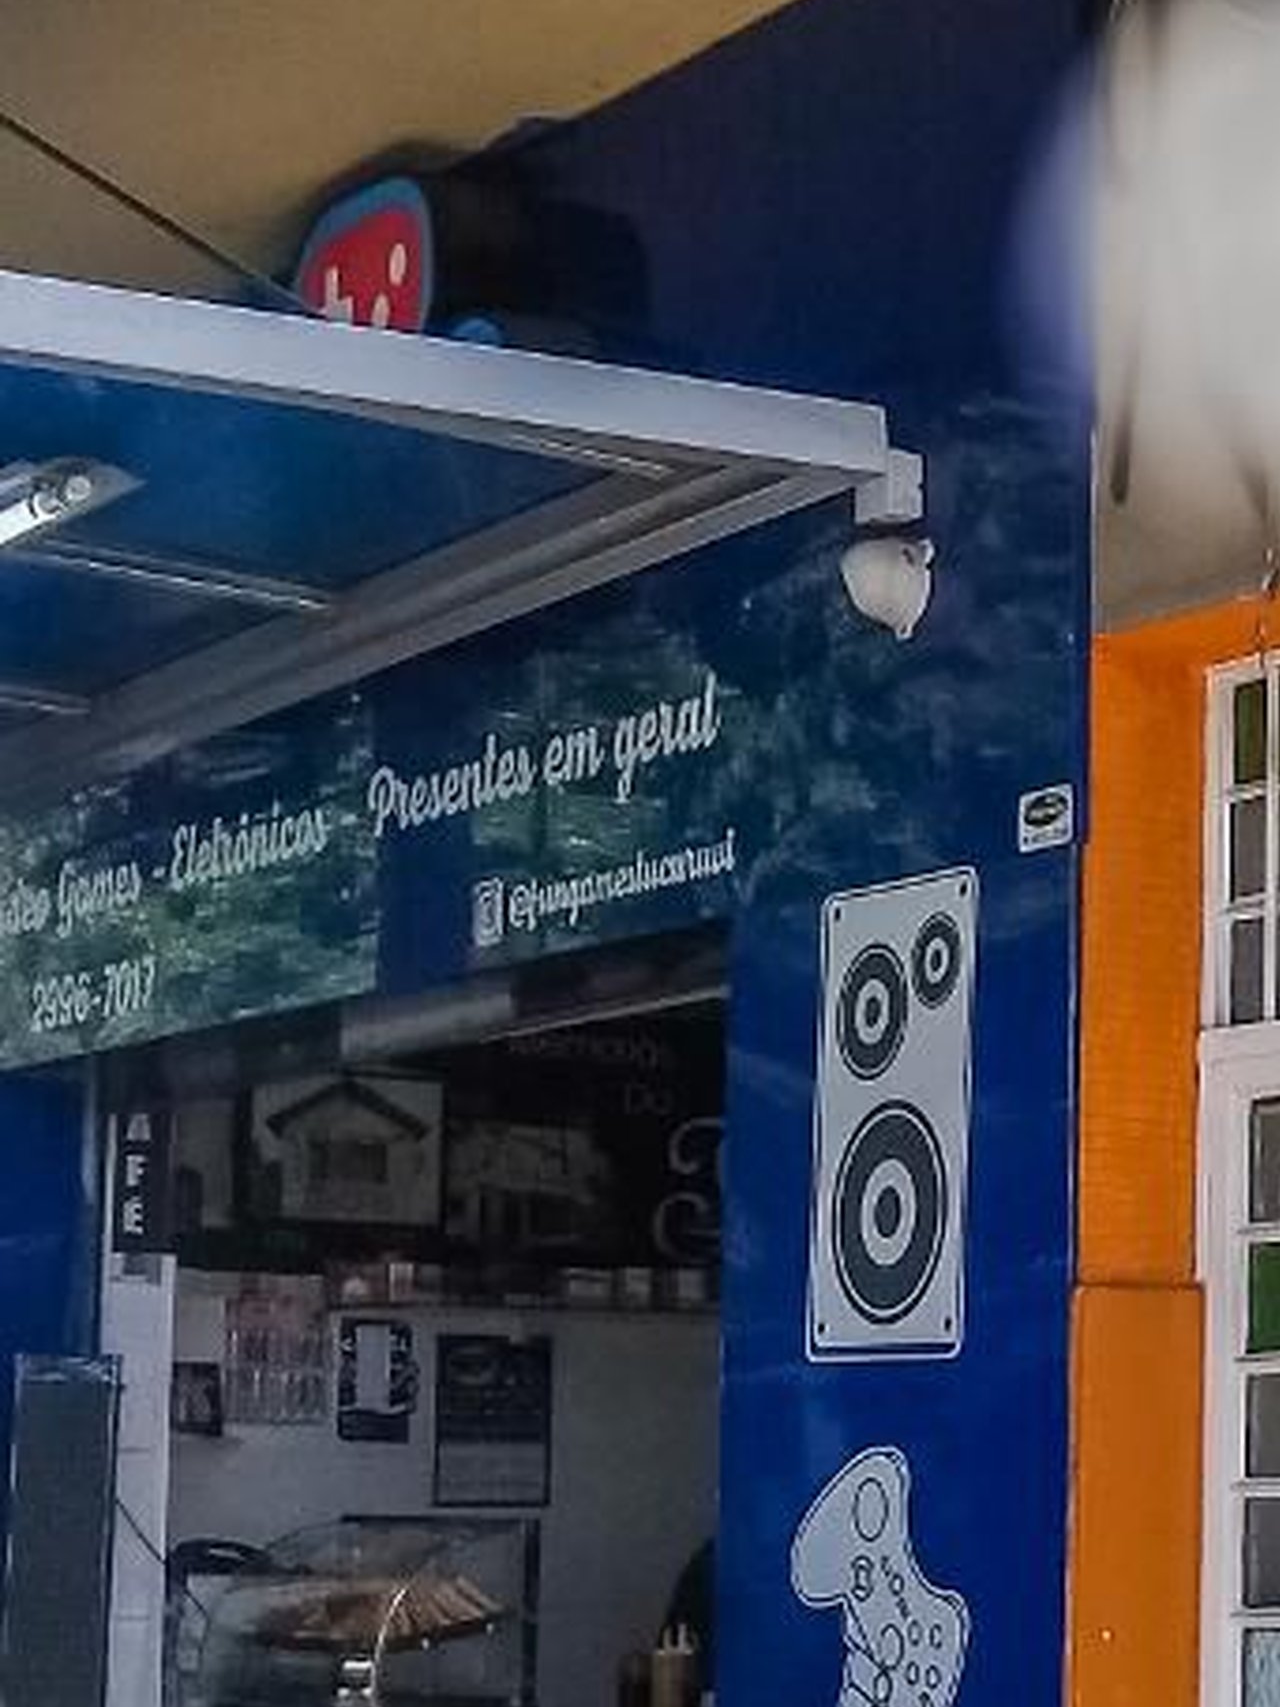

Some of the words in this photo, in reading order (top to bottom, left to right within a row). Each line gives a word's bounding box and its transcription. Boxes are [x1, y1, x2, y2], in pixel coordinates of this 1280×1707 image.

[55, 861, 142, 938] Games
[368, 734, 538, 836] Presentes
[545, 722, 608, 786] em
[613, 672, 722, 801] geral
